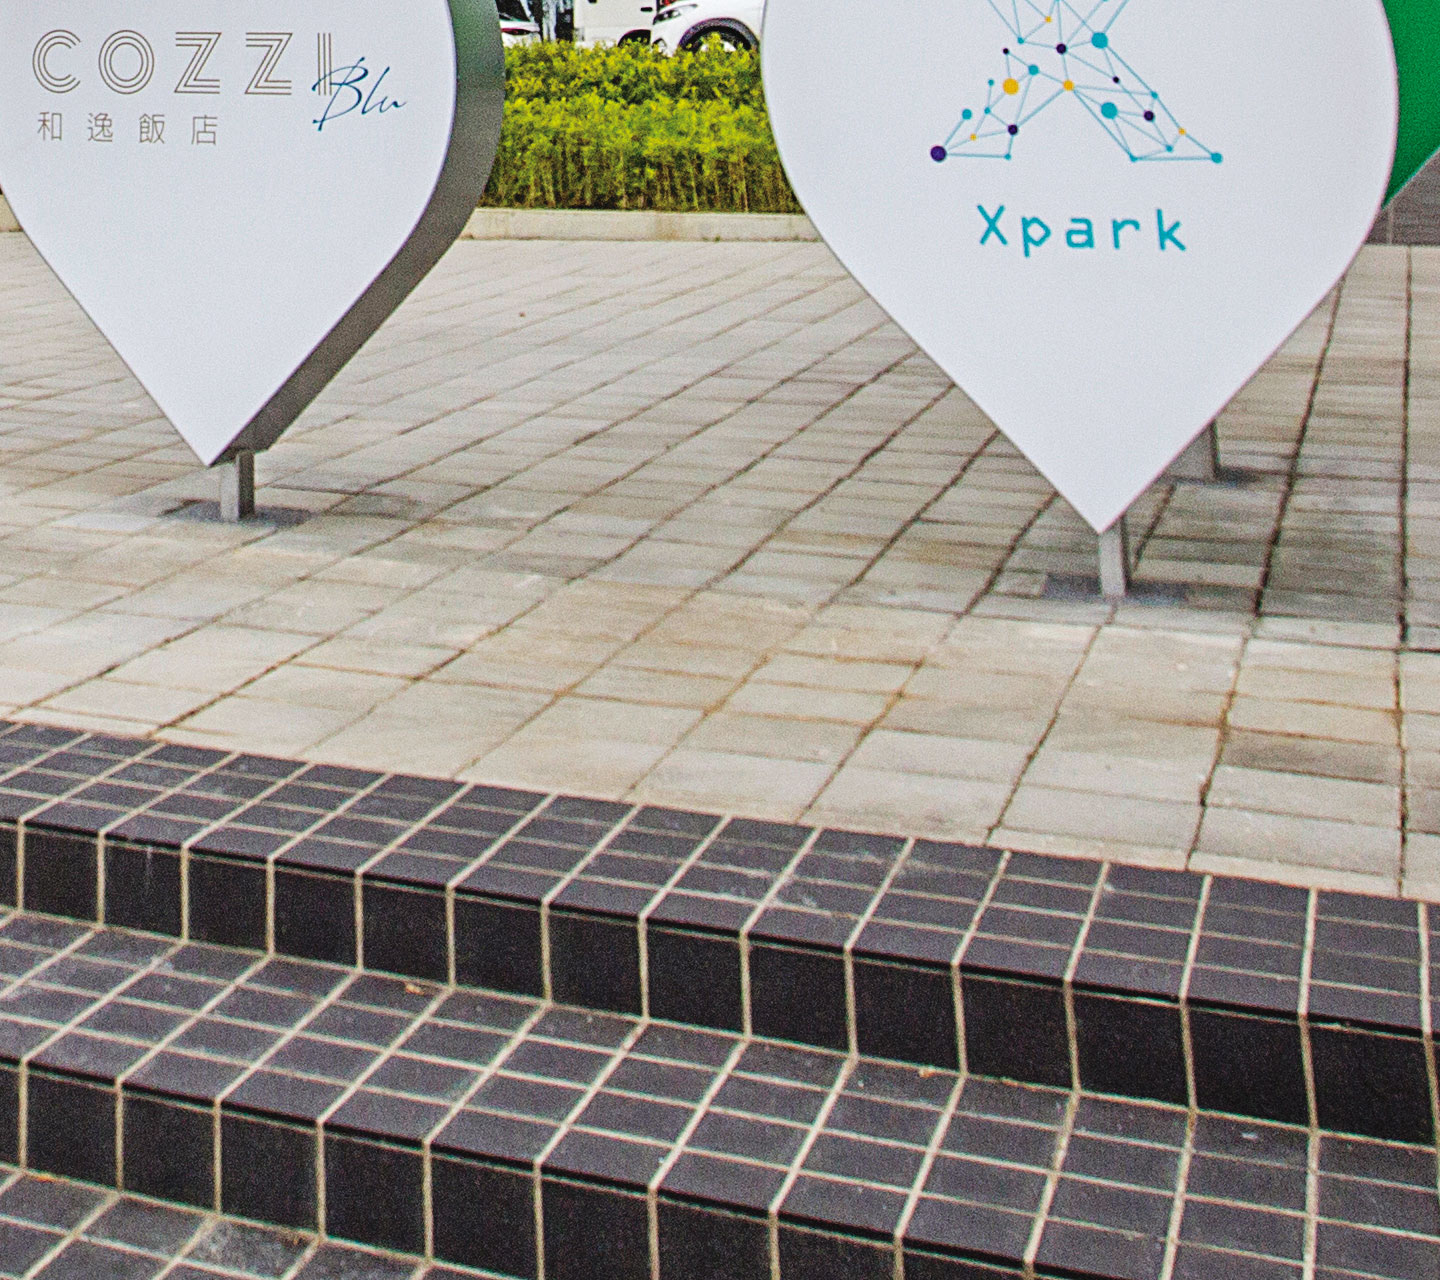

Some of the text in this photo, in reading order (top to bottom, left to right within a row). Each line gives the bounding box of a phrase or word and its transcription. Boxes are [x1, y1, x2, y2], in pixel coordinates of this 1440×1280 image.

[32, 29, 407, 131] COZZI Blu
[37, 111, 218, 146] 和逸飯店
[977, 204, 1186, 258] Xpark
